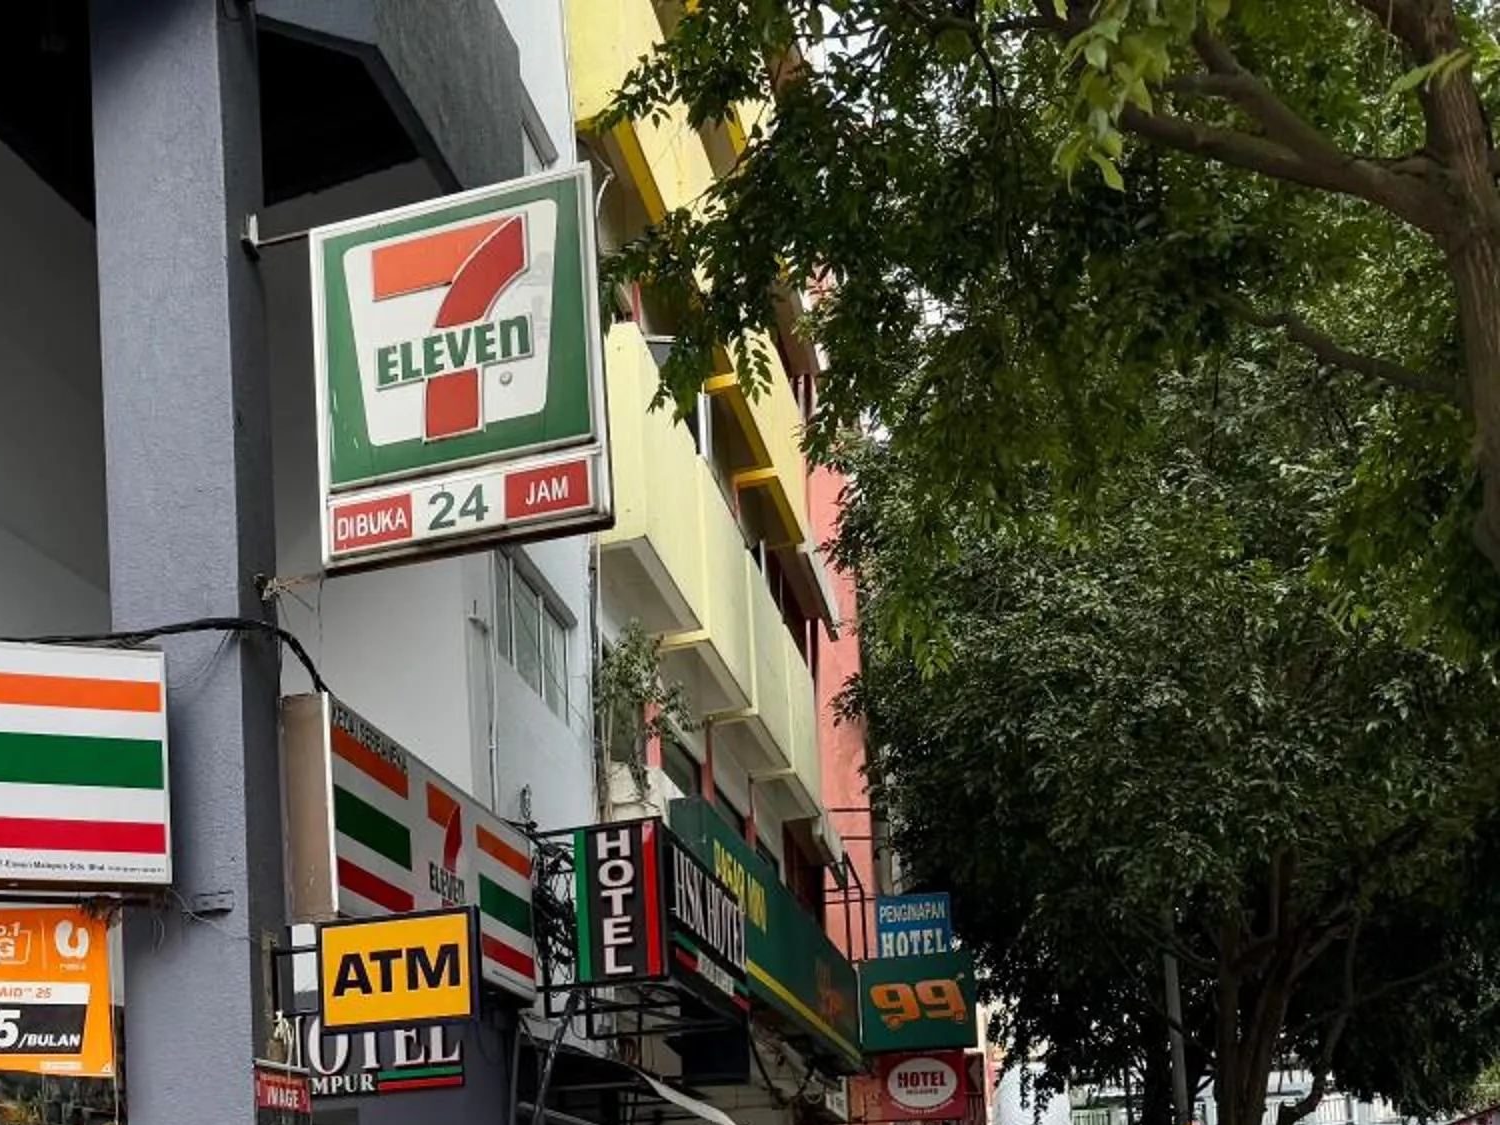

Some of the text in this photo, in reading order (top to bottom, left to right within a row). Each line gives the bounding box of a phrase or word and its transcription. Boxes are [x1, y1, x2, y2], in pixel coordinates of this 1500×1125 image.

[372, 214, 525, 438] 7
[336, 475, 571, 541] DIBUKA 24 JAM
[595, 829, 635, 975] HOTEL
[332, 943, 461, 997] ATM
[880, 927, 948, 959] HOTEL
[35, 988, 53, 999] 25
[869, 978, 968, 1034] 99
[18, 1032, 81, 1050] /BULAN
[897, 1070, 948, 1089] HOTEL
